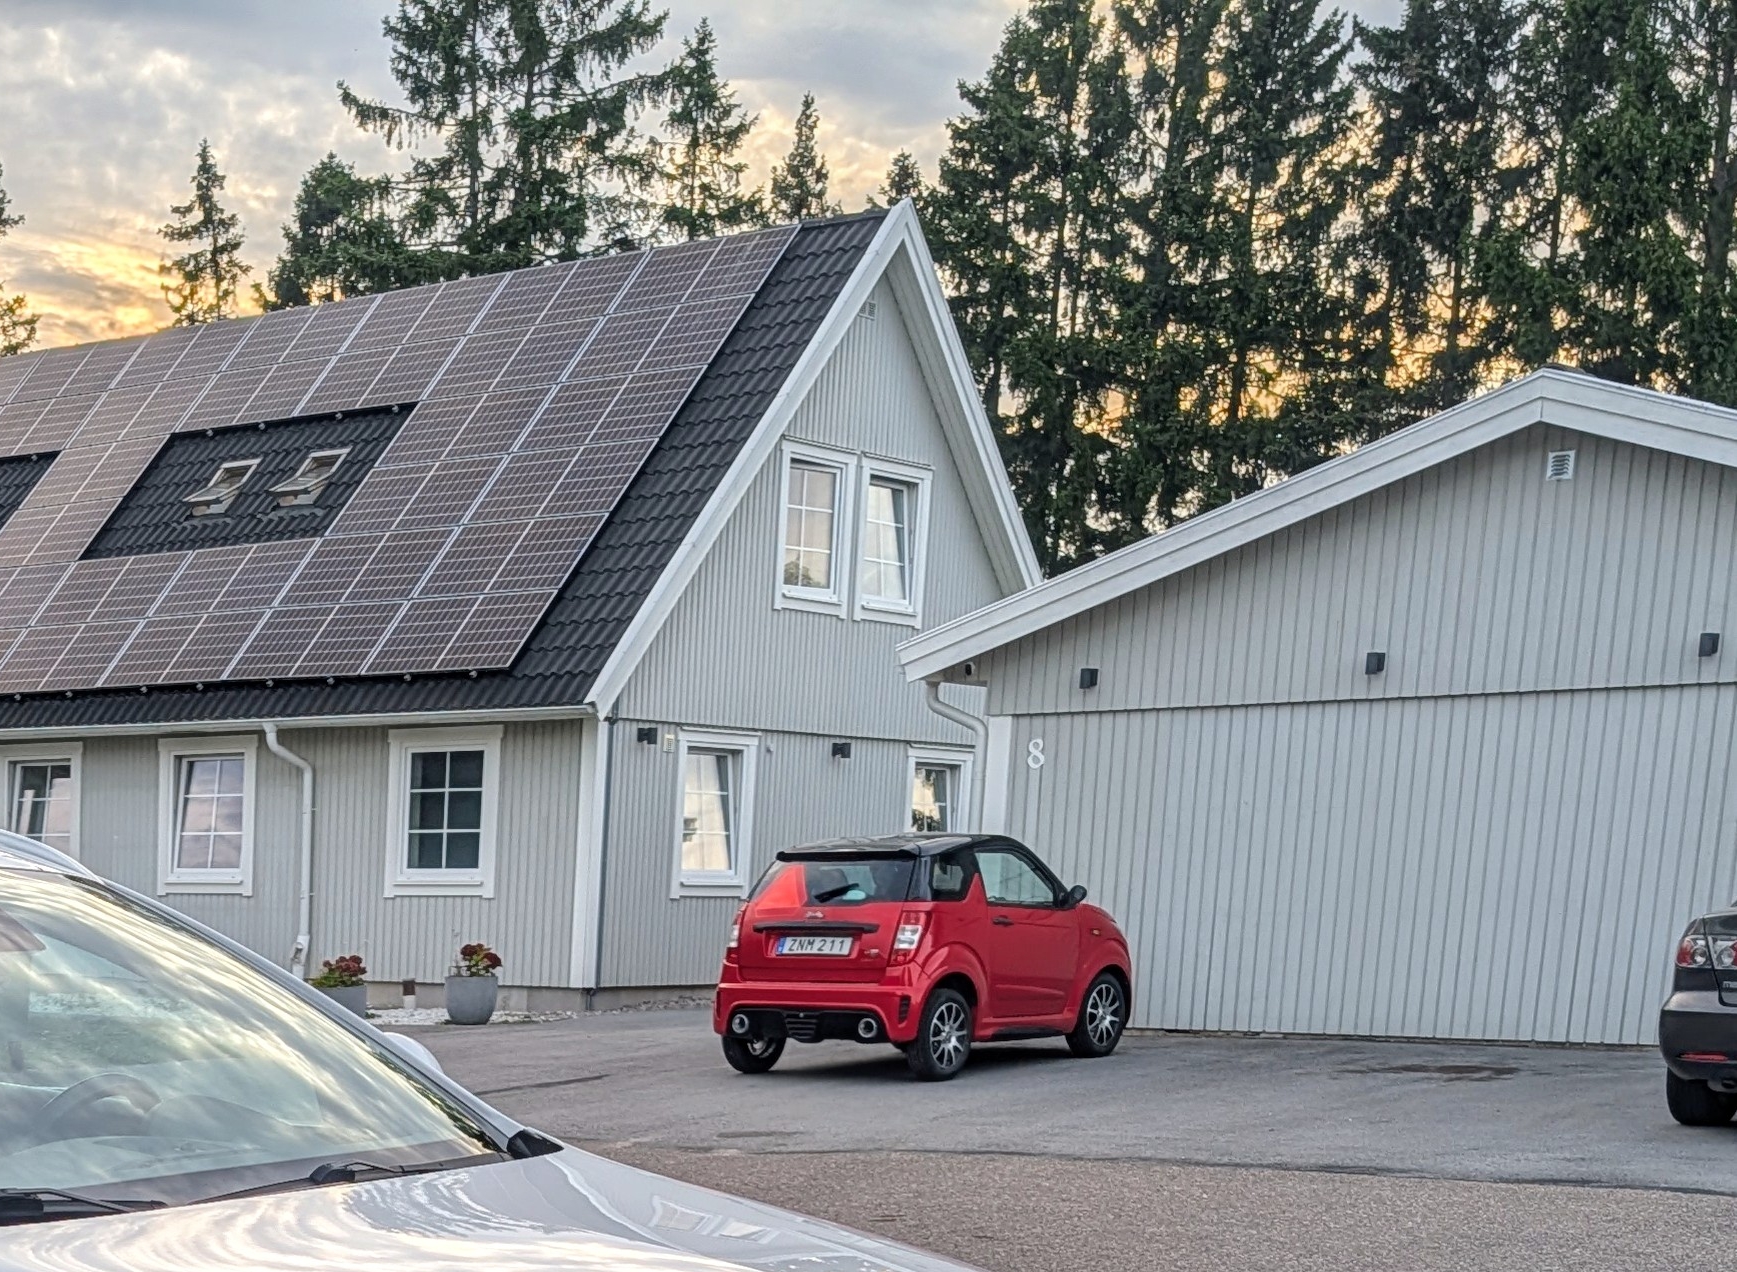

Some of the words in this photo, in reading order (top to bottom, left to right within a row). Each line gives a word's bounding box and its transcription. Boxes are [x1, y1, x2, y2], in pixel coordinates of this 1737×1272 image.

[1027, 738, 1045, 769] 8
[788, 938, 815, 952] ZNM
[817, 938, 845, 952] 211
